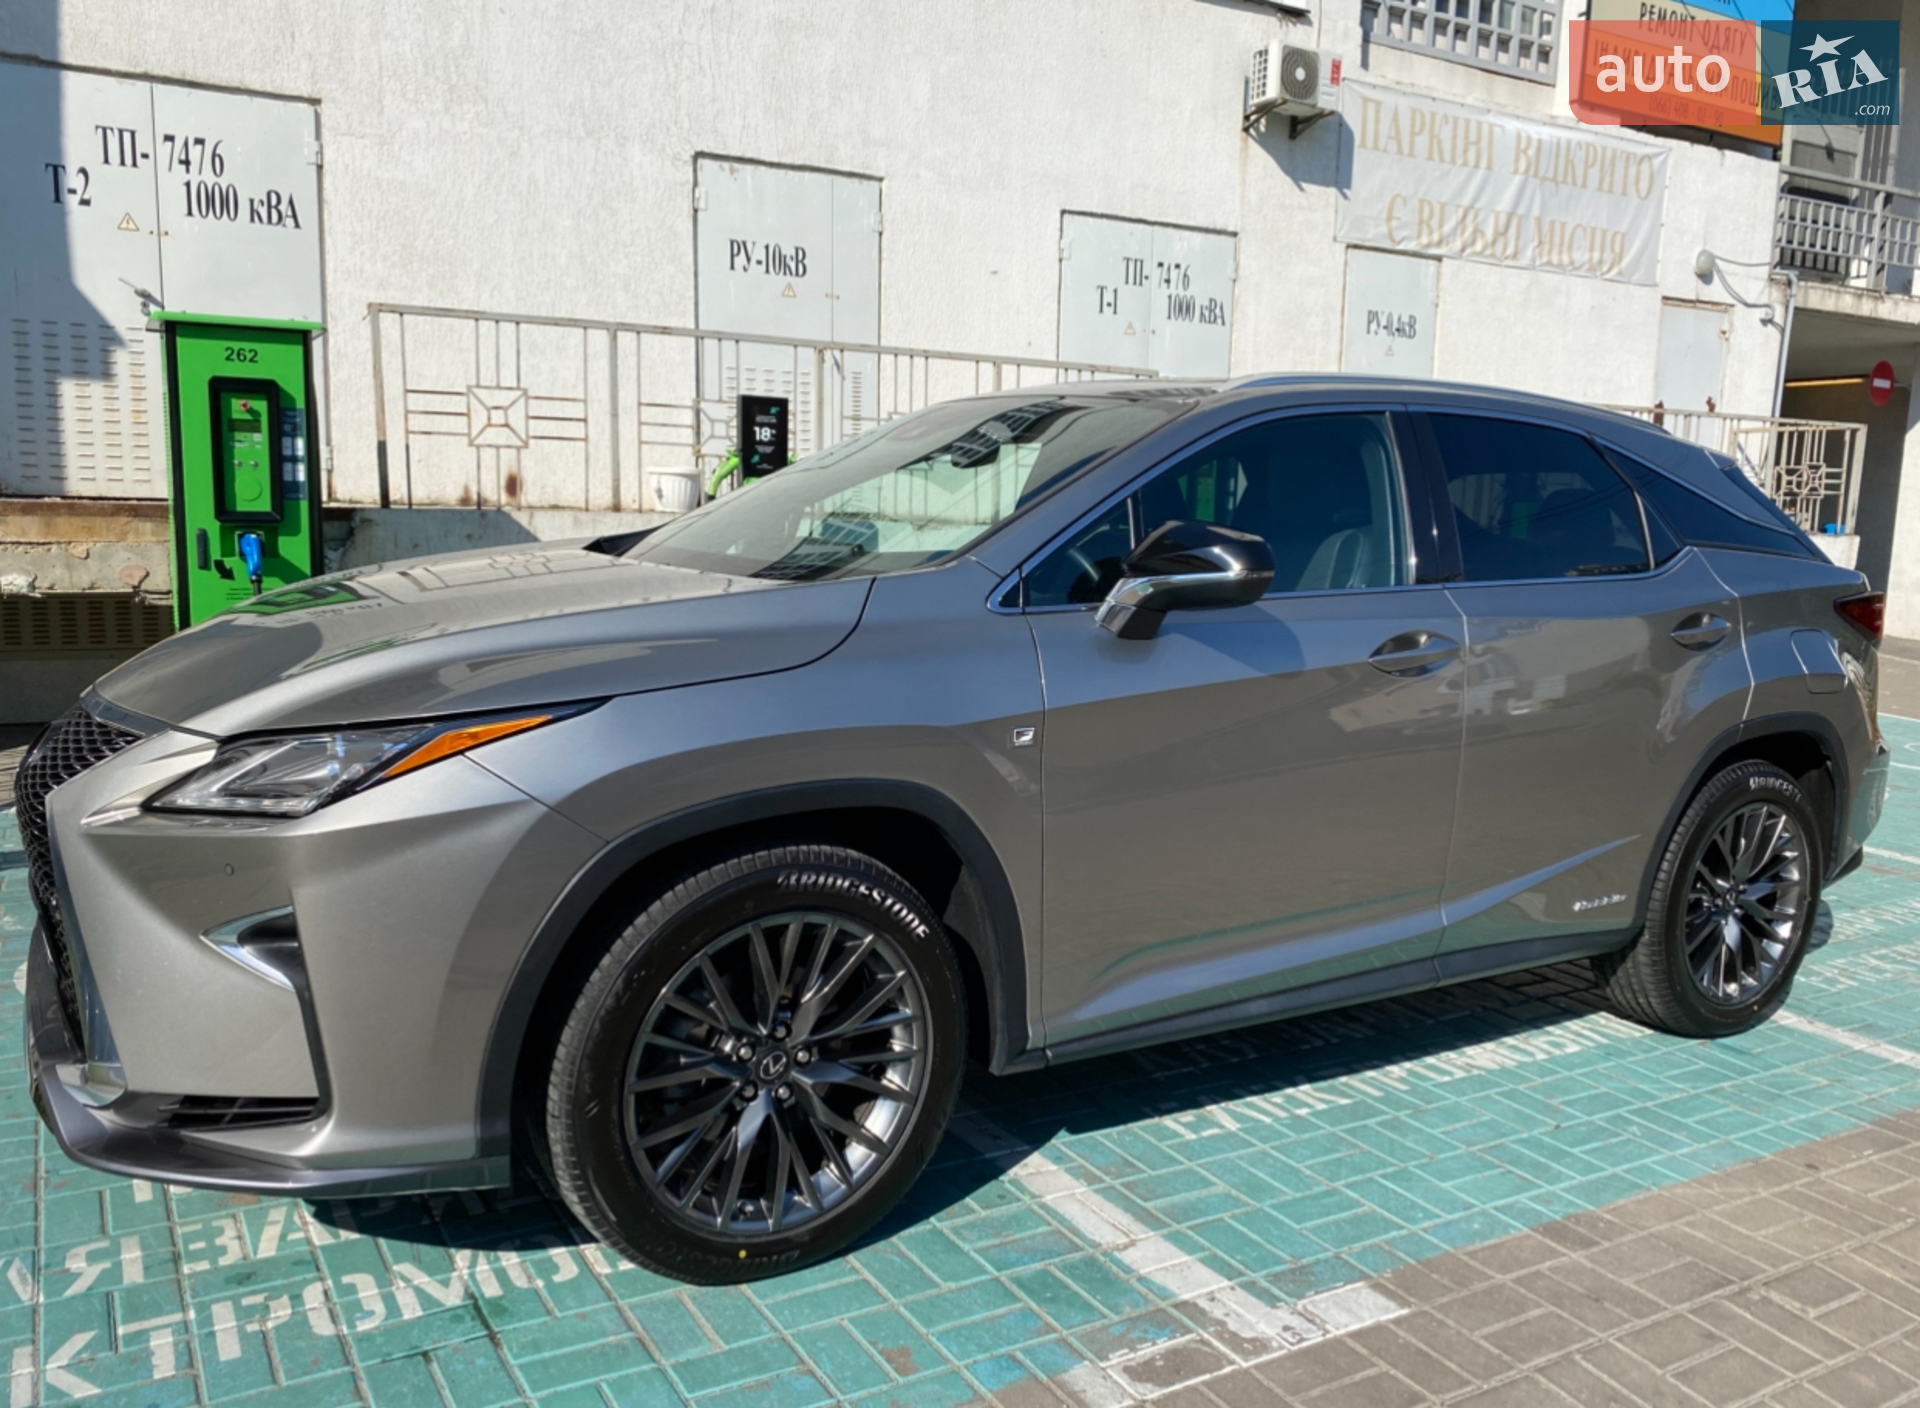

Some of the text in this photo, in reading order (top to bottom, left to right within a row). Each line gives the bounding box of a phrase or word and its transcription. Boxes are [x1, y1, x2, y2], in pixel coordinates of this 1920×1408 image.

[1639, 2, 1696, 42] РЕМОНТ
[95, 124, 225, 178] ТП- 7476
[1357, 96, 1656, 201] ПАРКІНГ ВІДКРИТО
[45, 162, 92, 207] Т-2
[183, 179, 302, 229] 1000 кВА
[1385, 193, 1408, 246] Є
[1533, 215, 1628, 277] МІСЦЯ
[728, 238, 808, 278] РУ-10кВ
[1123, 256, 1191, 292] ТП- 7476
[1097, 285, 1118, 315] Т-1
[1166, 293, 1226, 327] 1000 кВА
[224, 346, 259, 364] 262
[777, 868, 931, 942] BRIDGESTONE
